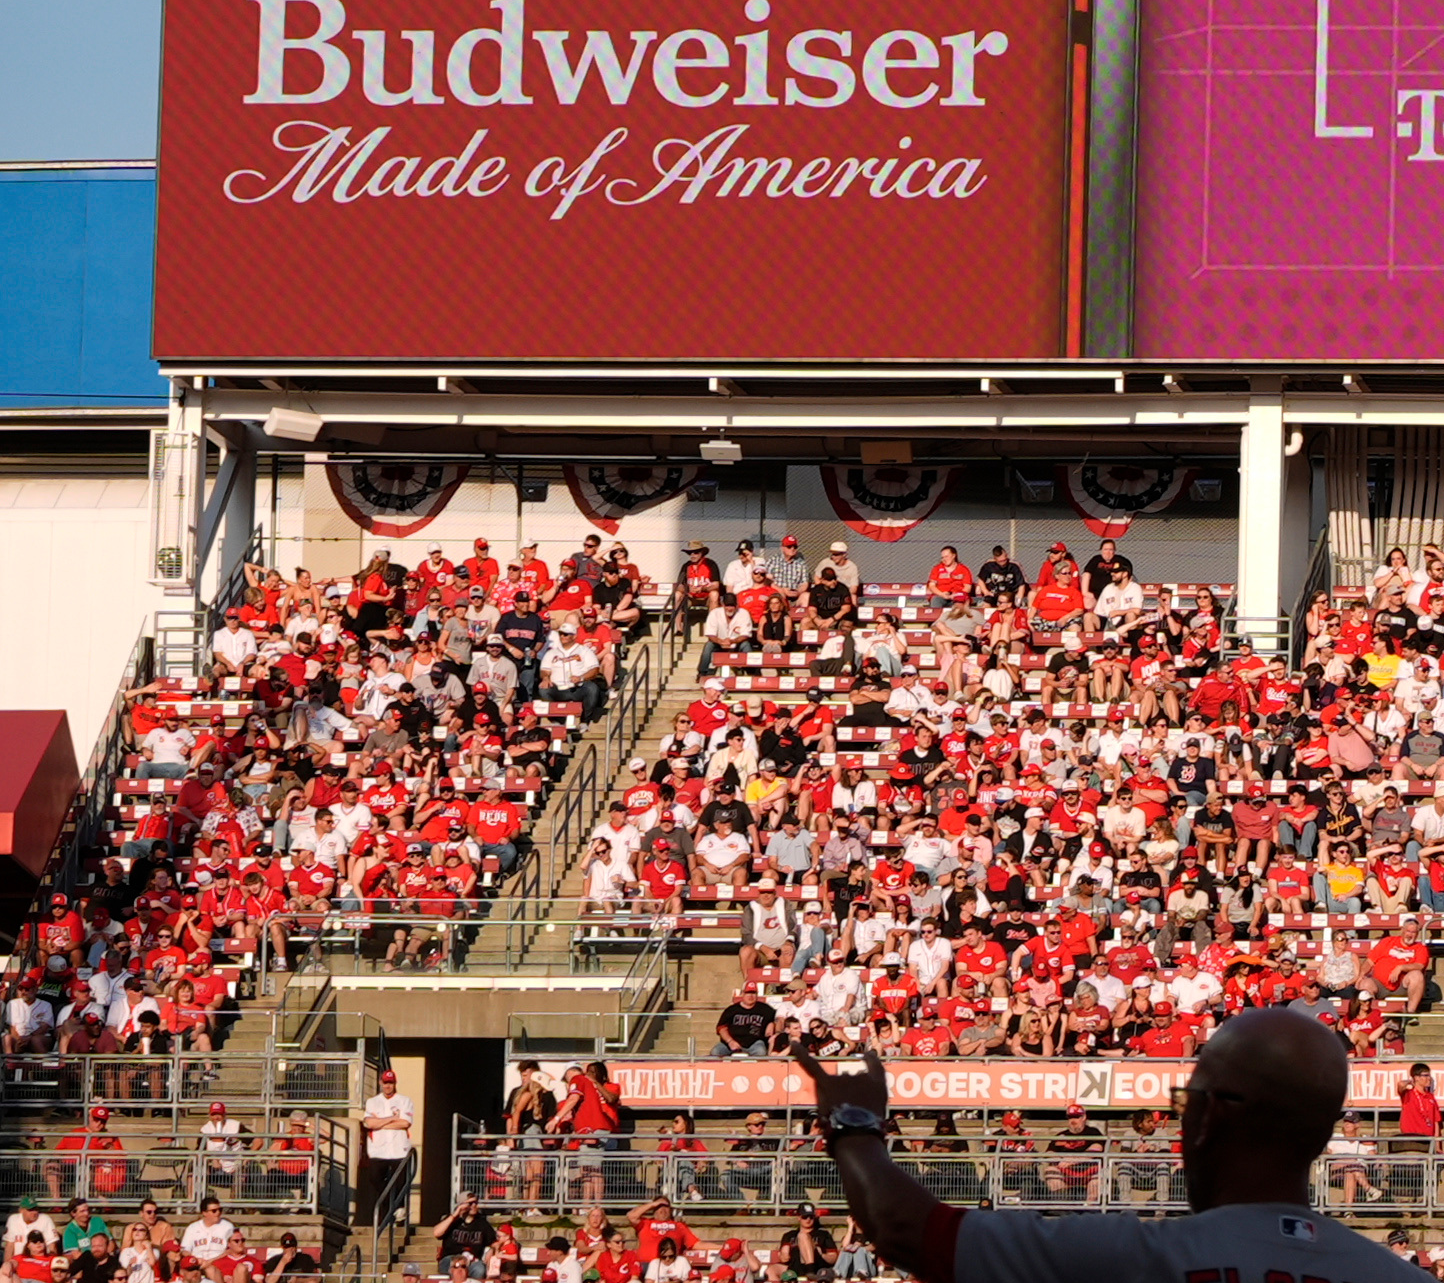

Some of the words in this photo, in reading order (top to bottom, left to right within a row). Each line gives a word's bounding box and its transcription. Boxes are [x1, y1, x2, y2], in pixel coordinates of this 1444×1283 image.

[223, 121, 509, 203] Made
[527, 127, 628, 220] of
[606, 124, 987, 204] America
[868, 1068, 991, 1101] ROGER
